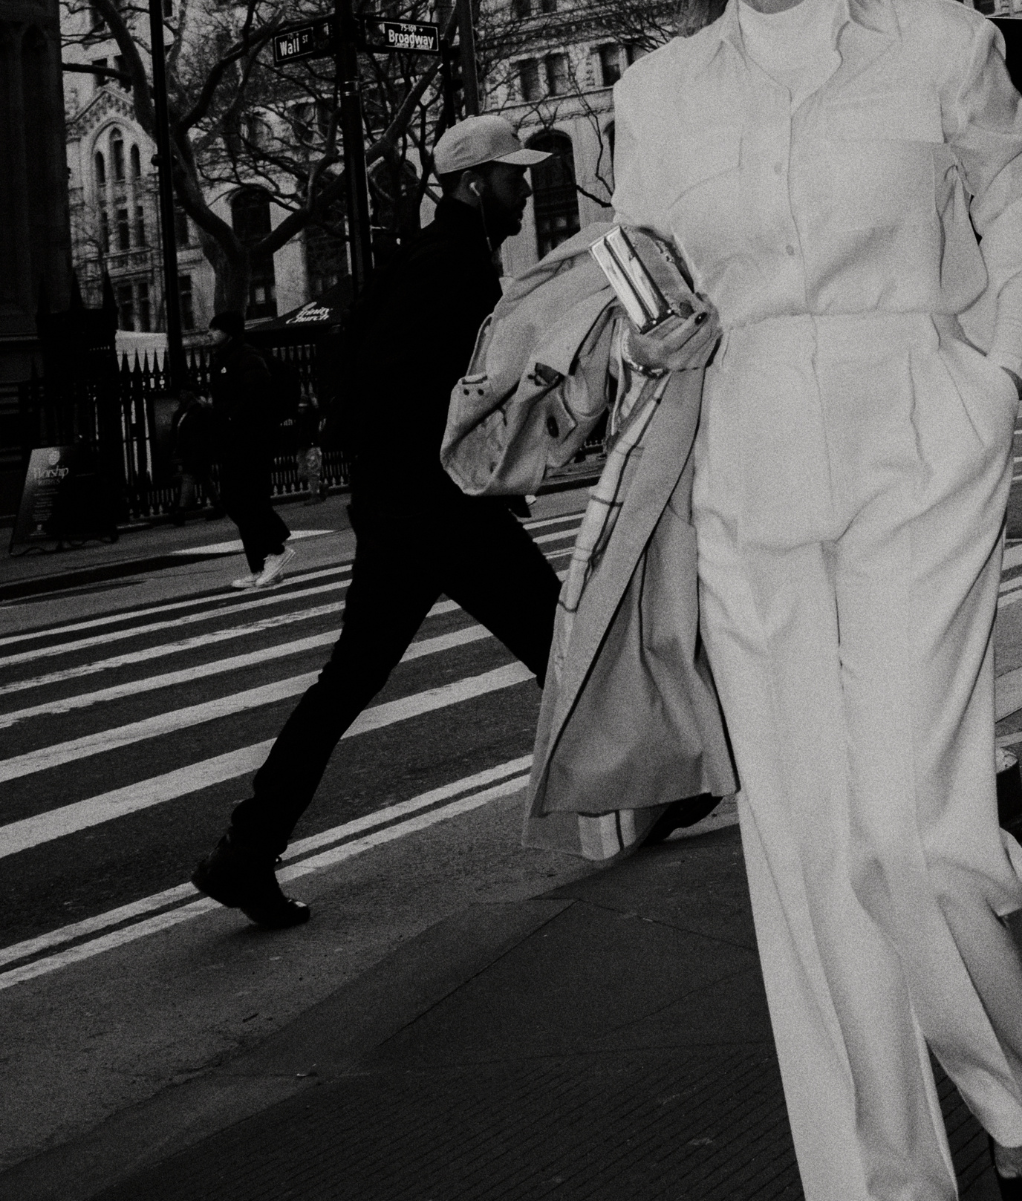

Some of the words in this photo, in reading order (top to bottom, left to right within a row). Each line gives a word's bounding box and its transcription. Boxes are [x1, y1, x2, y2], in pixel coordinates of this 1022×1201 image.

[279, 37, 300, 57] Wall
[301, 34, 309, 44] ST
[388, 29, 434, 49] Broadway
